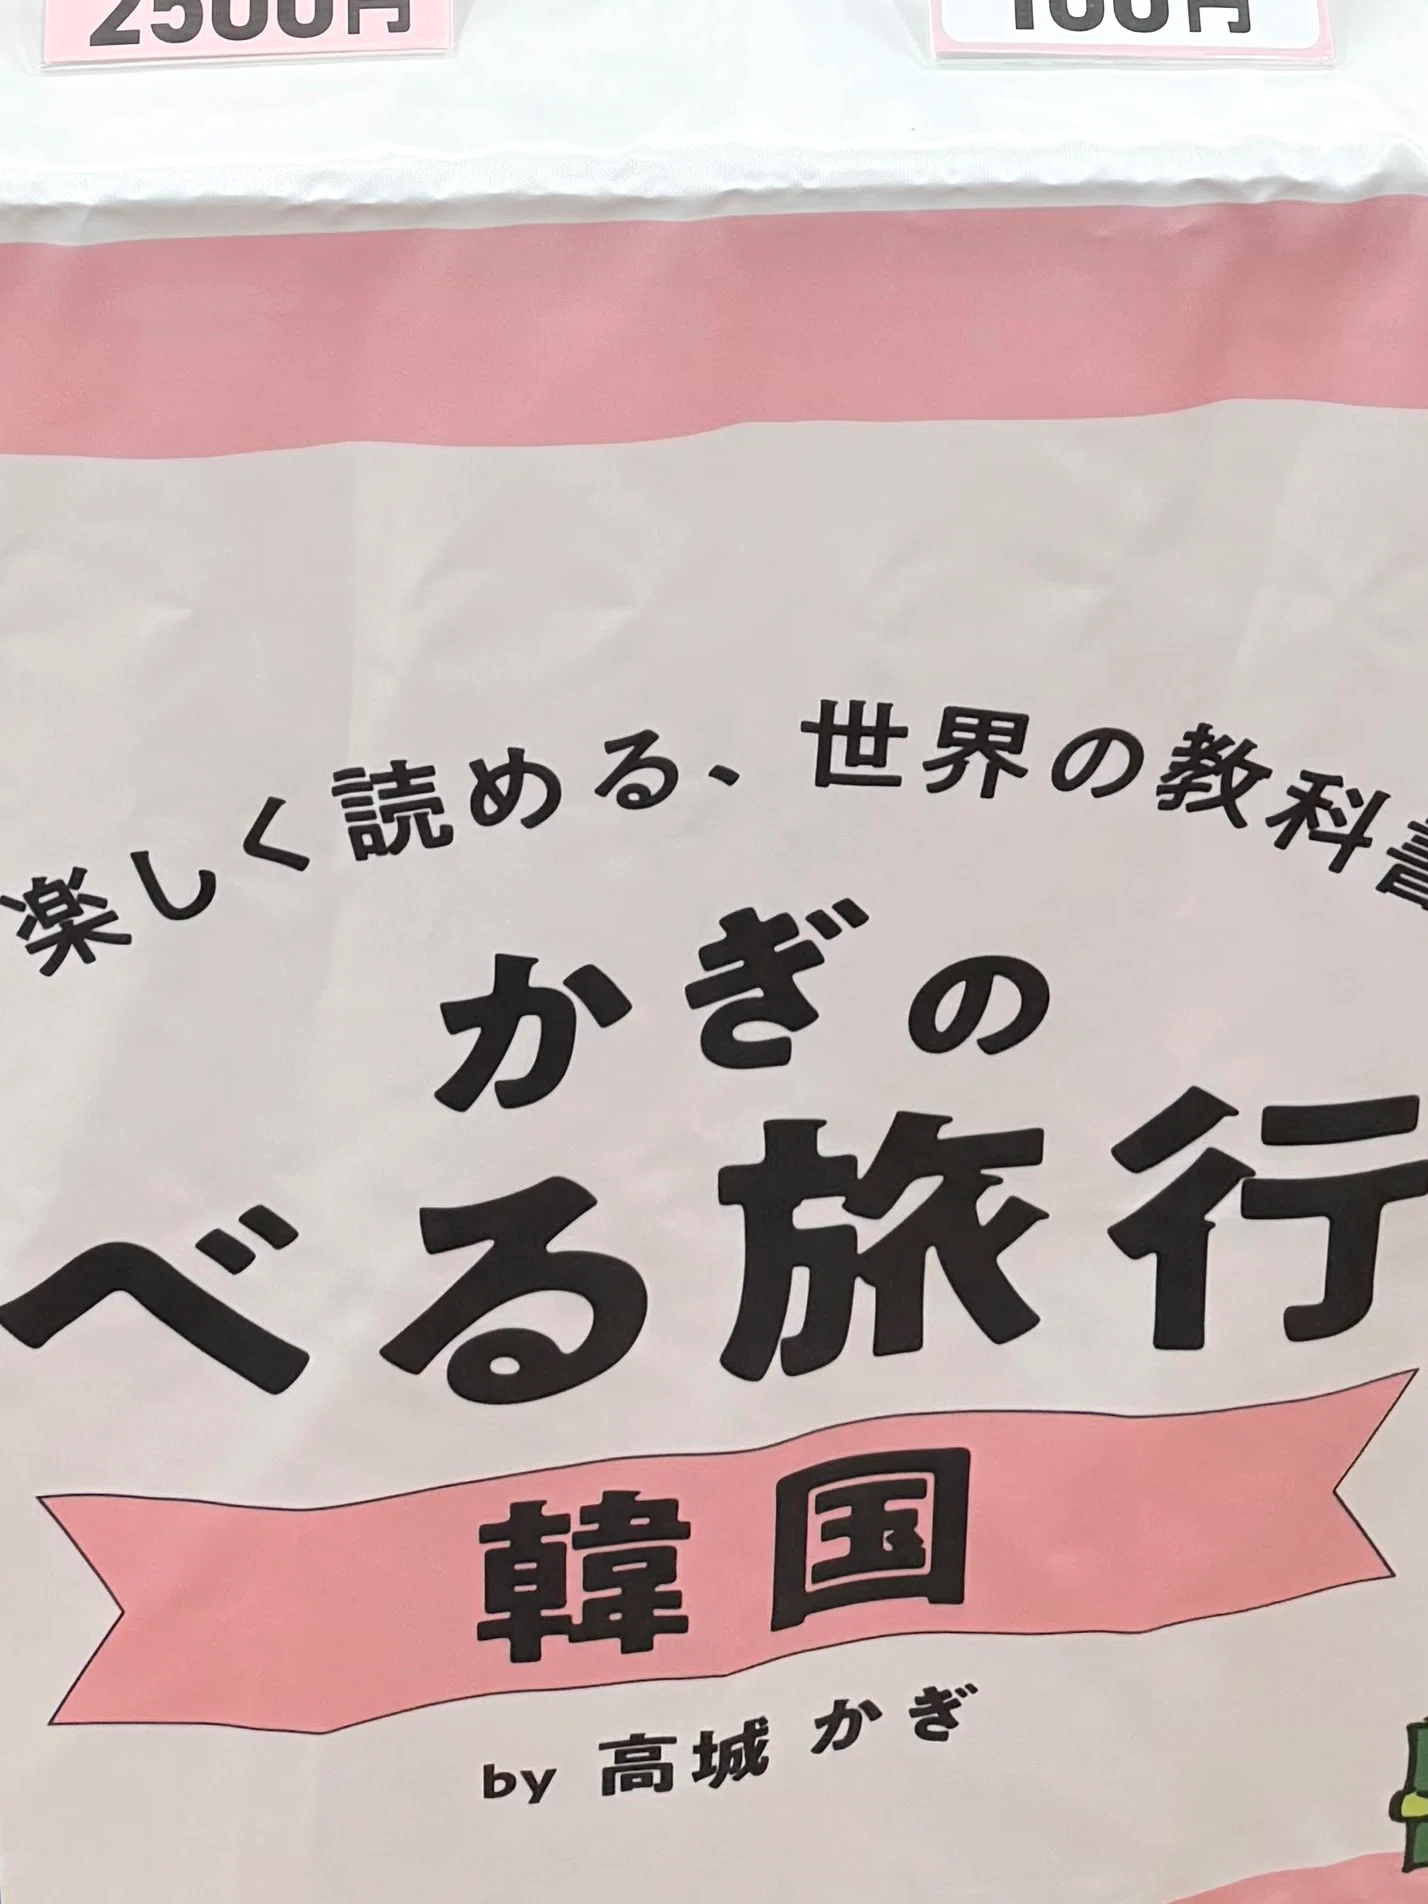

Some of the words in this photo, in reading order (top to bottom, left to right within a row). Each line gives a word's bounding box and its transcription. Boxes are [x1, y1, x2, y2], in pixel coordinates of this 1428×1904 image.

[431, 894, 1053, 1117] かぎの
[474, 1444, 974, 1667] 韓国
[481, 1764, 559, 1810] by
[598, 1715, 772, 1801] 高城
[812, 1681, 981, 1747] かぎ
